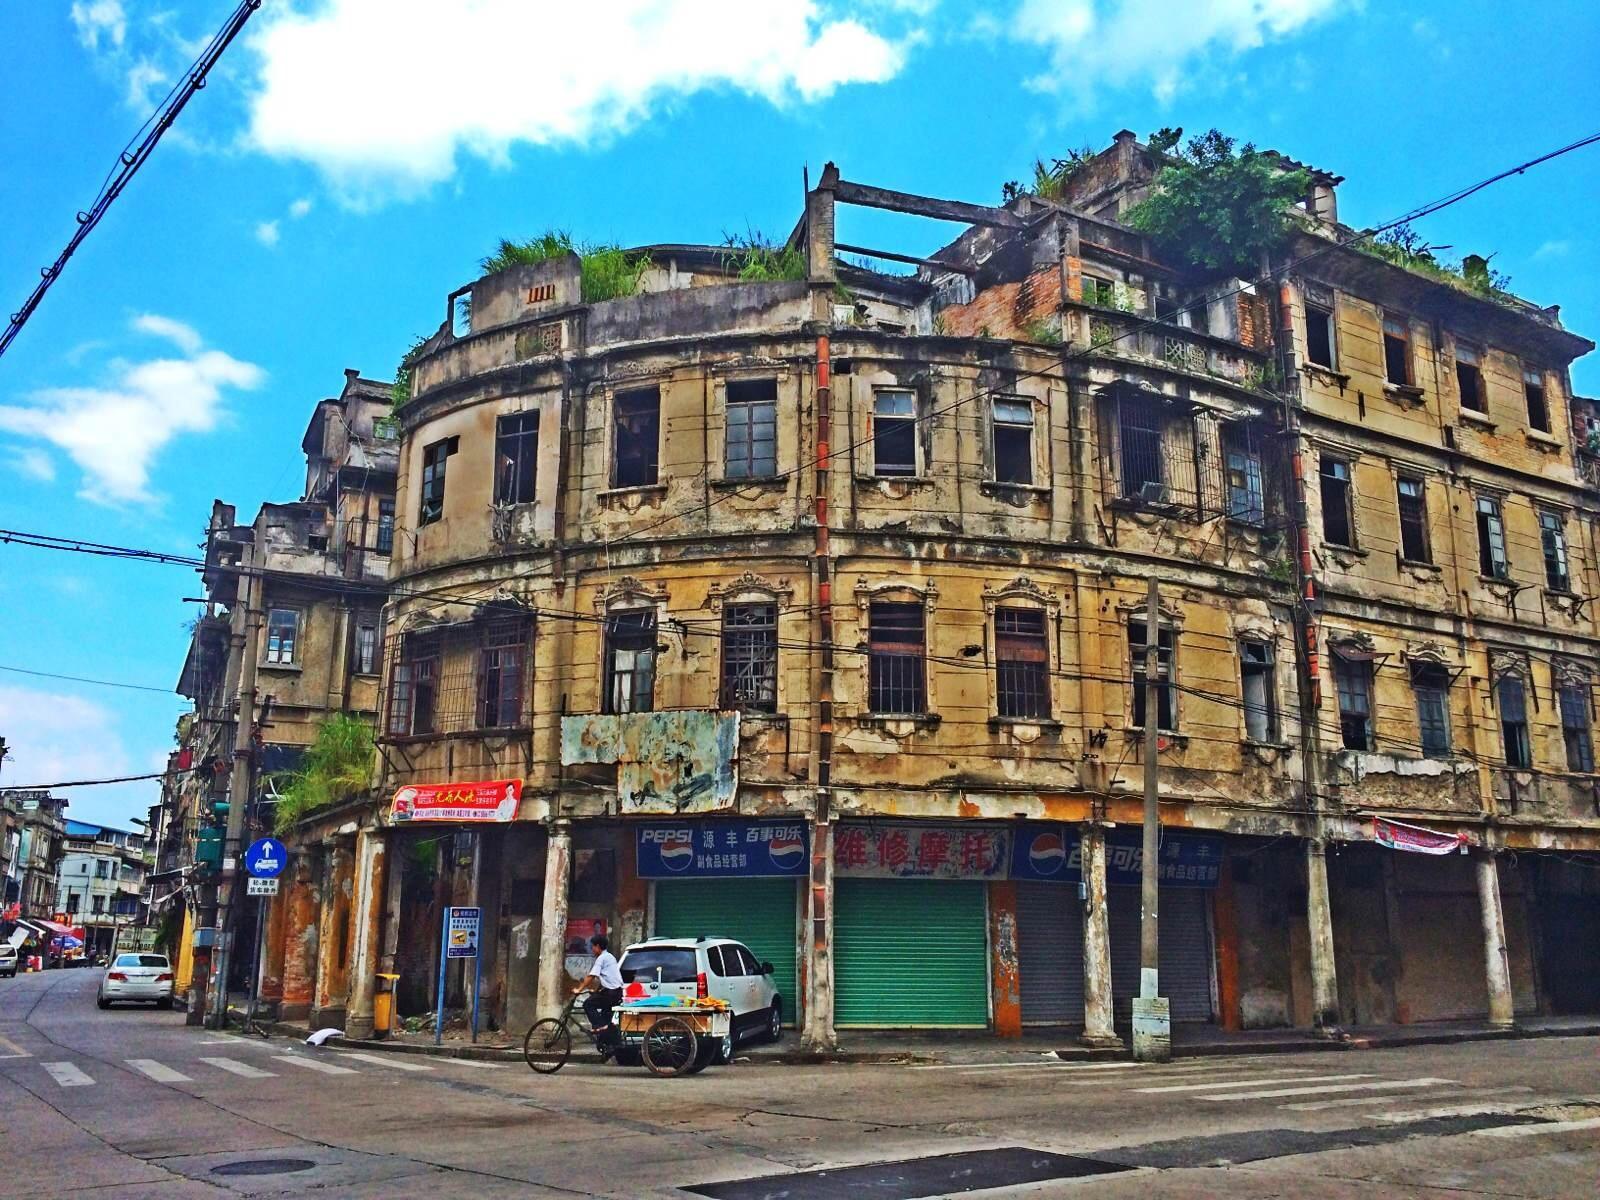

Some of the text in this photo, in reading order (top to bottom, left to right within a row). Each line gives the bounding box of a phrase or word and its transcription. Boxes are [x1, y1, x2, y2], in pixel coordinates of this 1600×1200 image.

[641, 829, 693, 843] PEPSI
[746, 826, 803, 843] 百事可乐
[836, 830, 992, 870] 维修摩托
[1066, 842, 1143, 872] 百可乐
[697, 853, 747, 870] 副食品经营部
